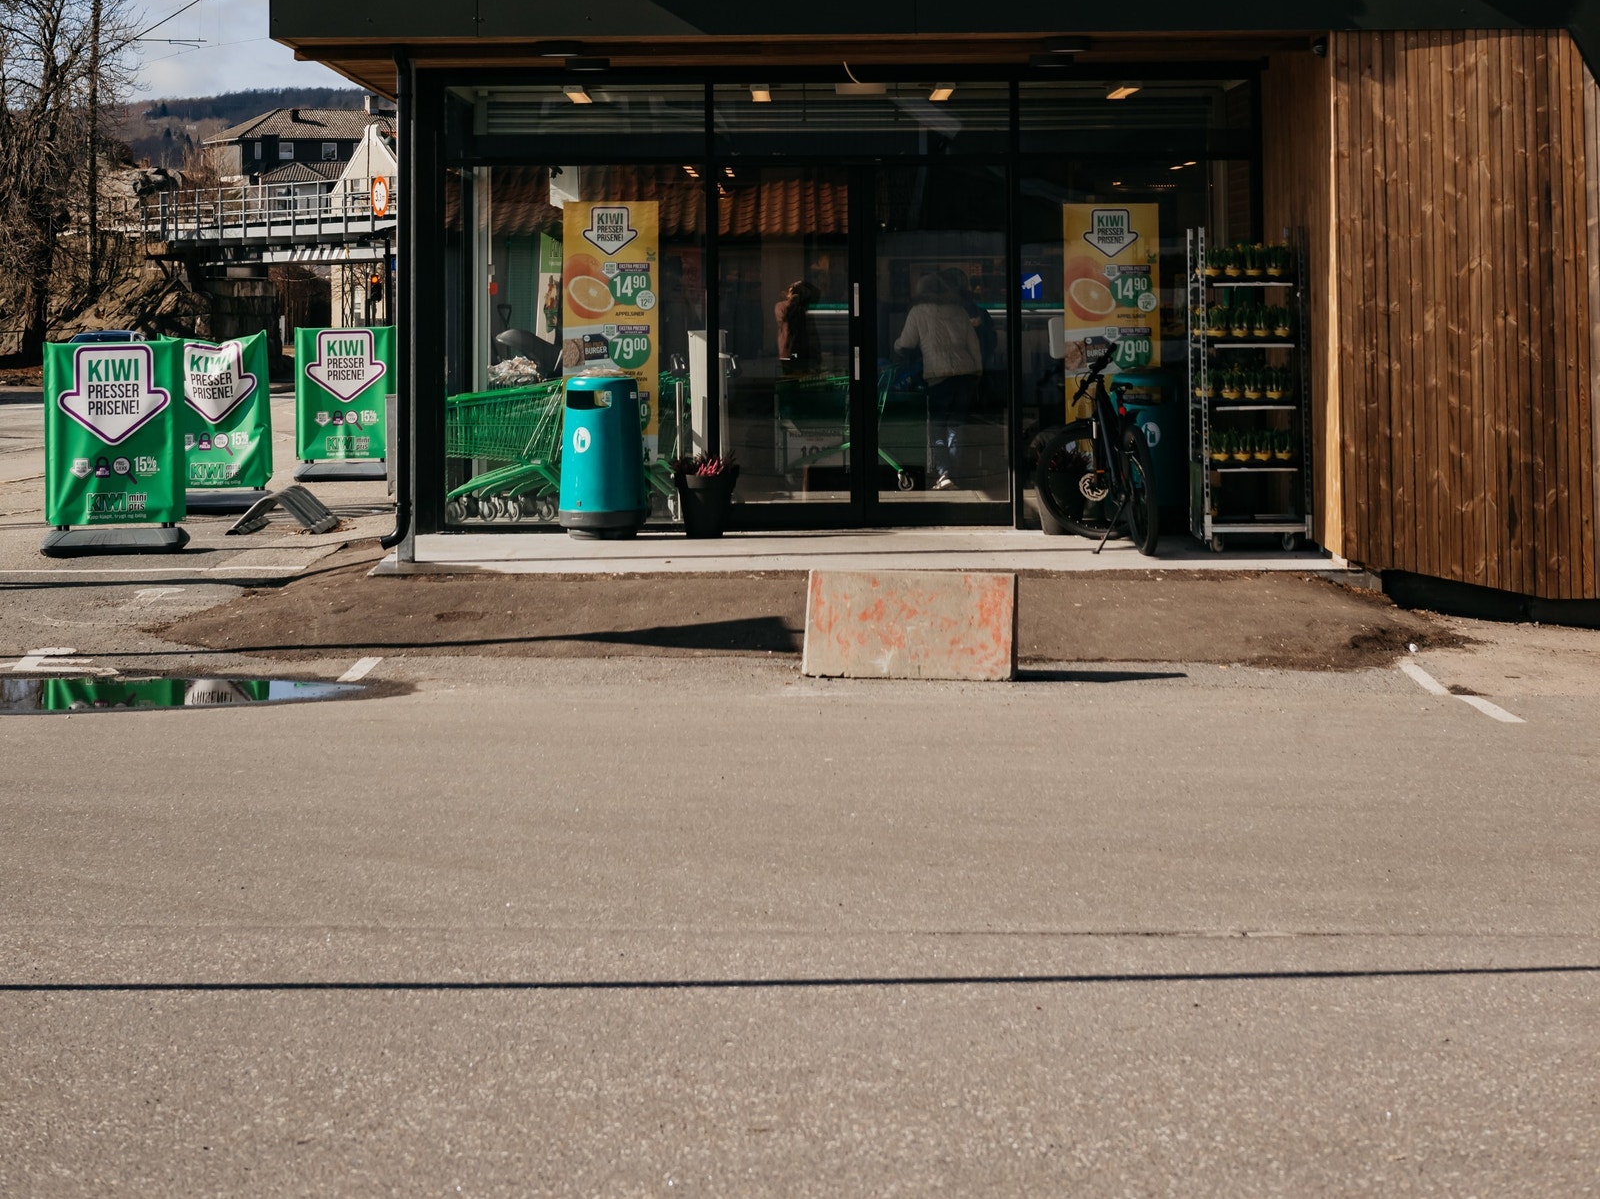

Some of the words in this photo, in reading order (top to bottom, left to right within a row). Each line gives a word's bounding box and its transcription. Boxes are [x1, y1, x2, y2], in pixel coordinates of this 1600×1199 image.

[596, 213, 624, 225] KIWI
[1097, 215, 1124, 227] KIWI
[596, 225, 624, 234] PRESSER
[1097, 227, 1124, 236] PRESSER
[596, 233, 624, 242] PRISENE!
[327, 339, 364, 357] KIWI
[585, 346, 608, 356] BURGER
[327, 357, 365, 369] PRESSER
[88, 358, 140, 382] KIWI
[327, 369, 365, 381] PRISENE!
[190, 371, 233, 387] PRESSER
[88, 383, 140, 400] PRESSER
[192, 385, 234, 400] PRISENE!
[88, 399, 140, 416] PRISENE!
[325, 436, 356, 451] KIWI
[190, 462, 226, 480] KIWI
[86, 492, 128, 513] KIWI
[128, 492, 148, 503] mini
[128, 502, 146, 513] pris
